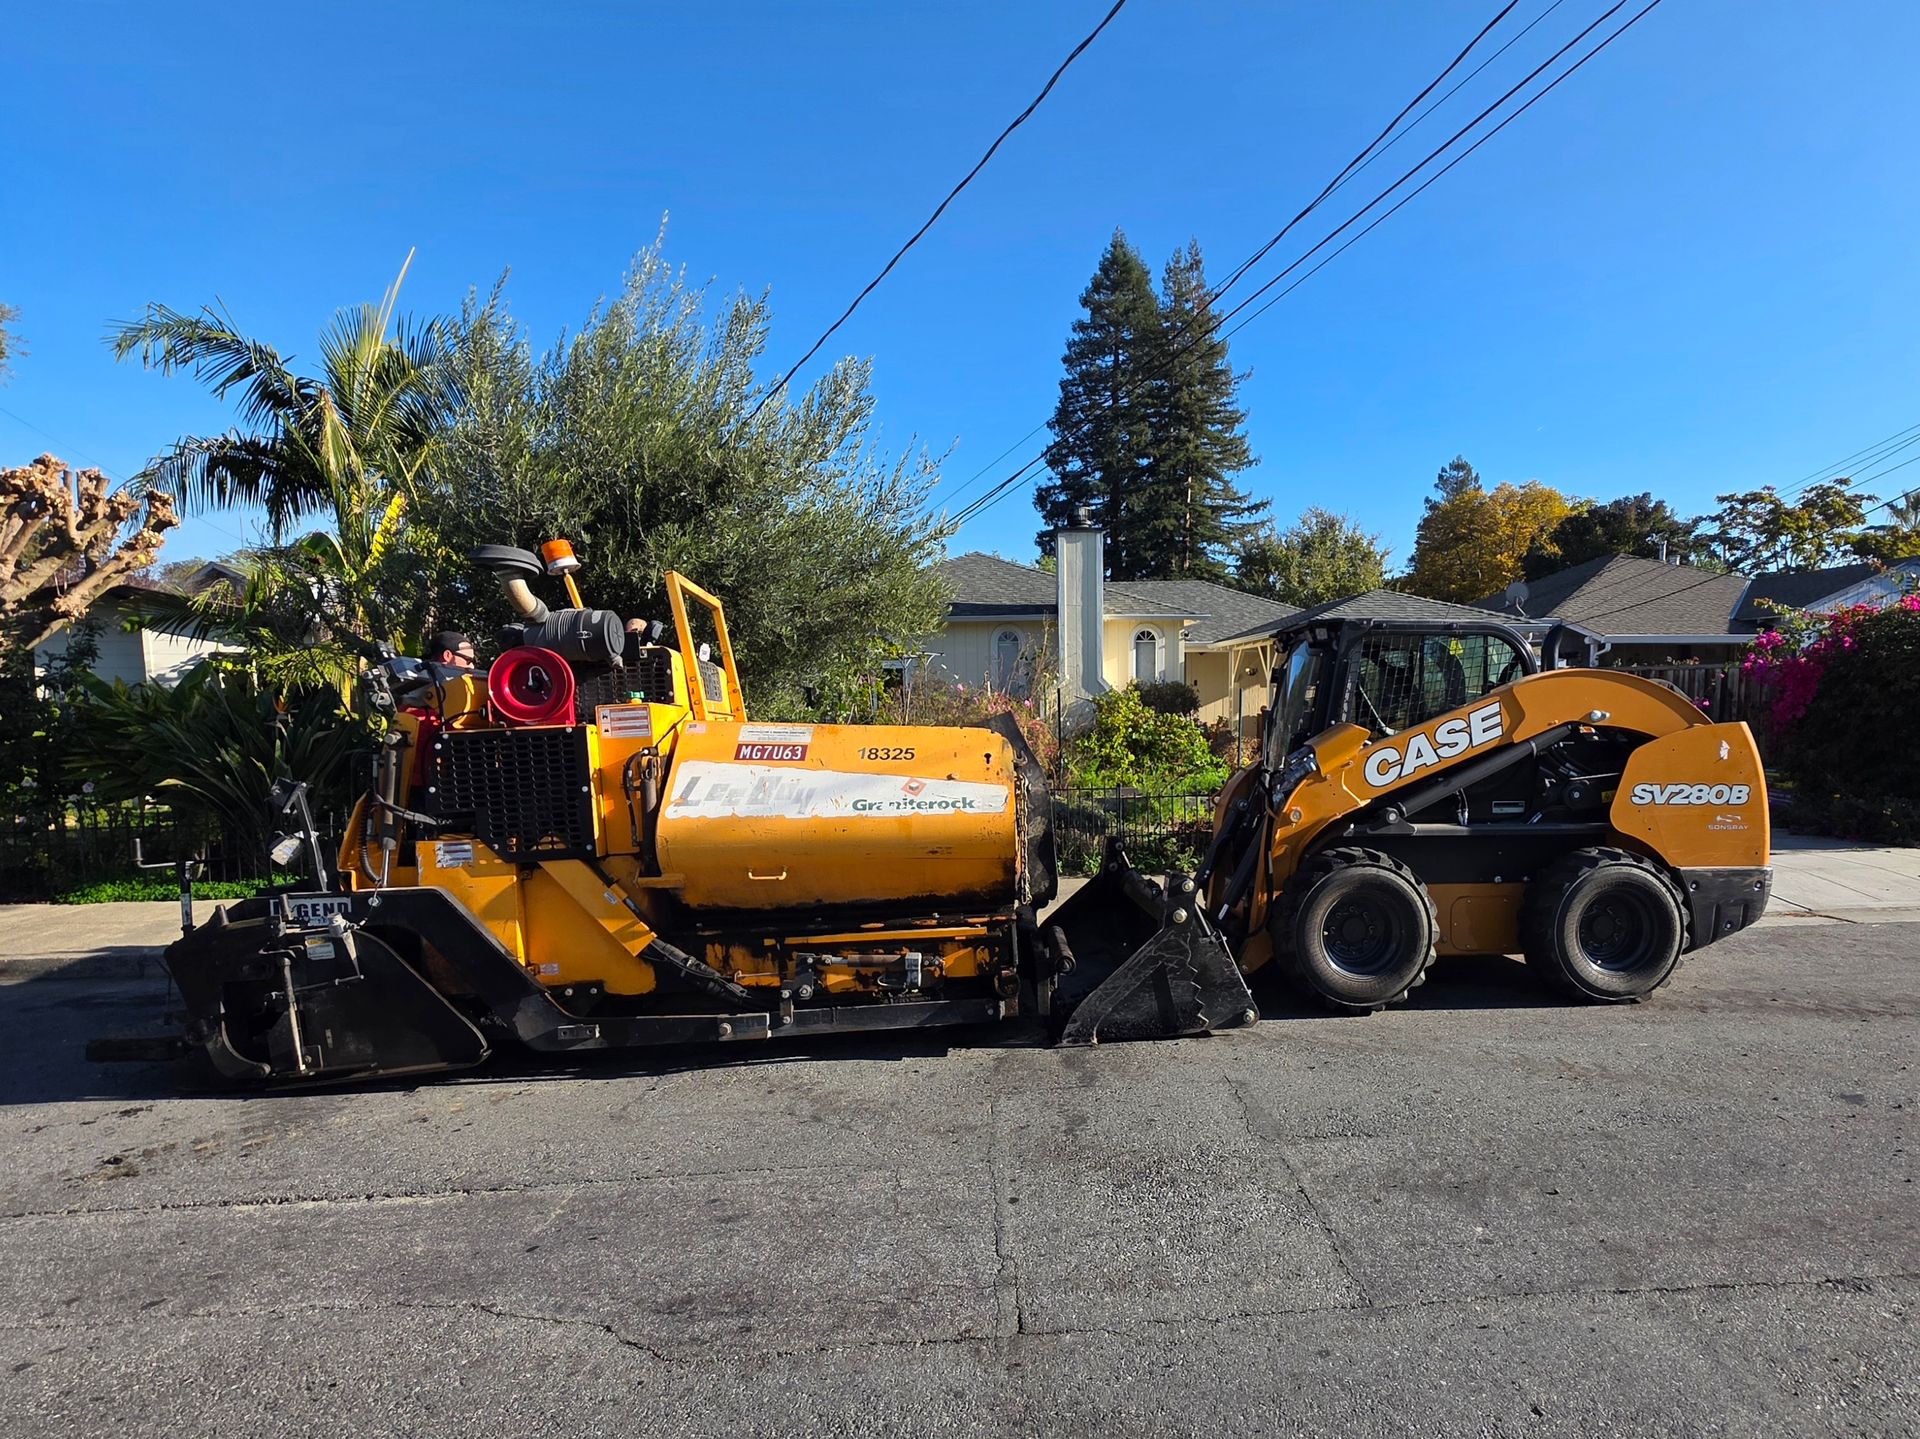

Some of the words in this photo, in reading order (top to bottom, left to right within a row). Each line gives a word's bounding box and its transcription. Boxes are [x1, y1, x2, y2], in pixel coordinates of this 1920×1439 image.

[739, 745, 803, 760] MG7U63
[1364, 701, 1504, 787] CASE
[858, 747, 916, 760] 18325
[1631, 783, 1751, 805] SV280B
[272, 901, 350, 919] LGEND
